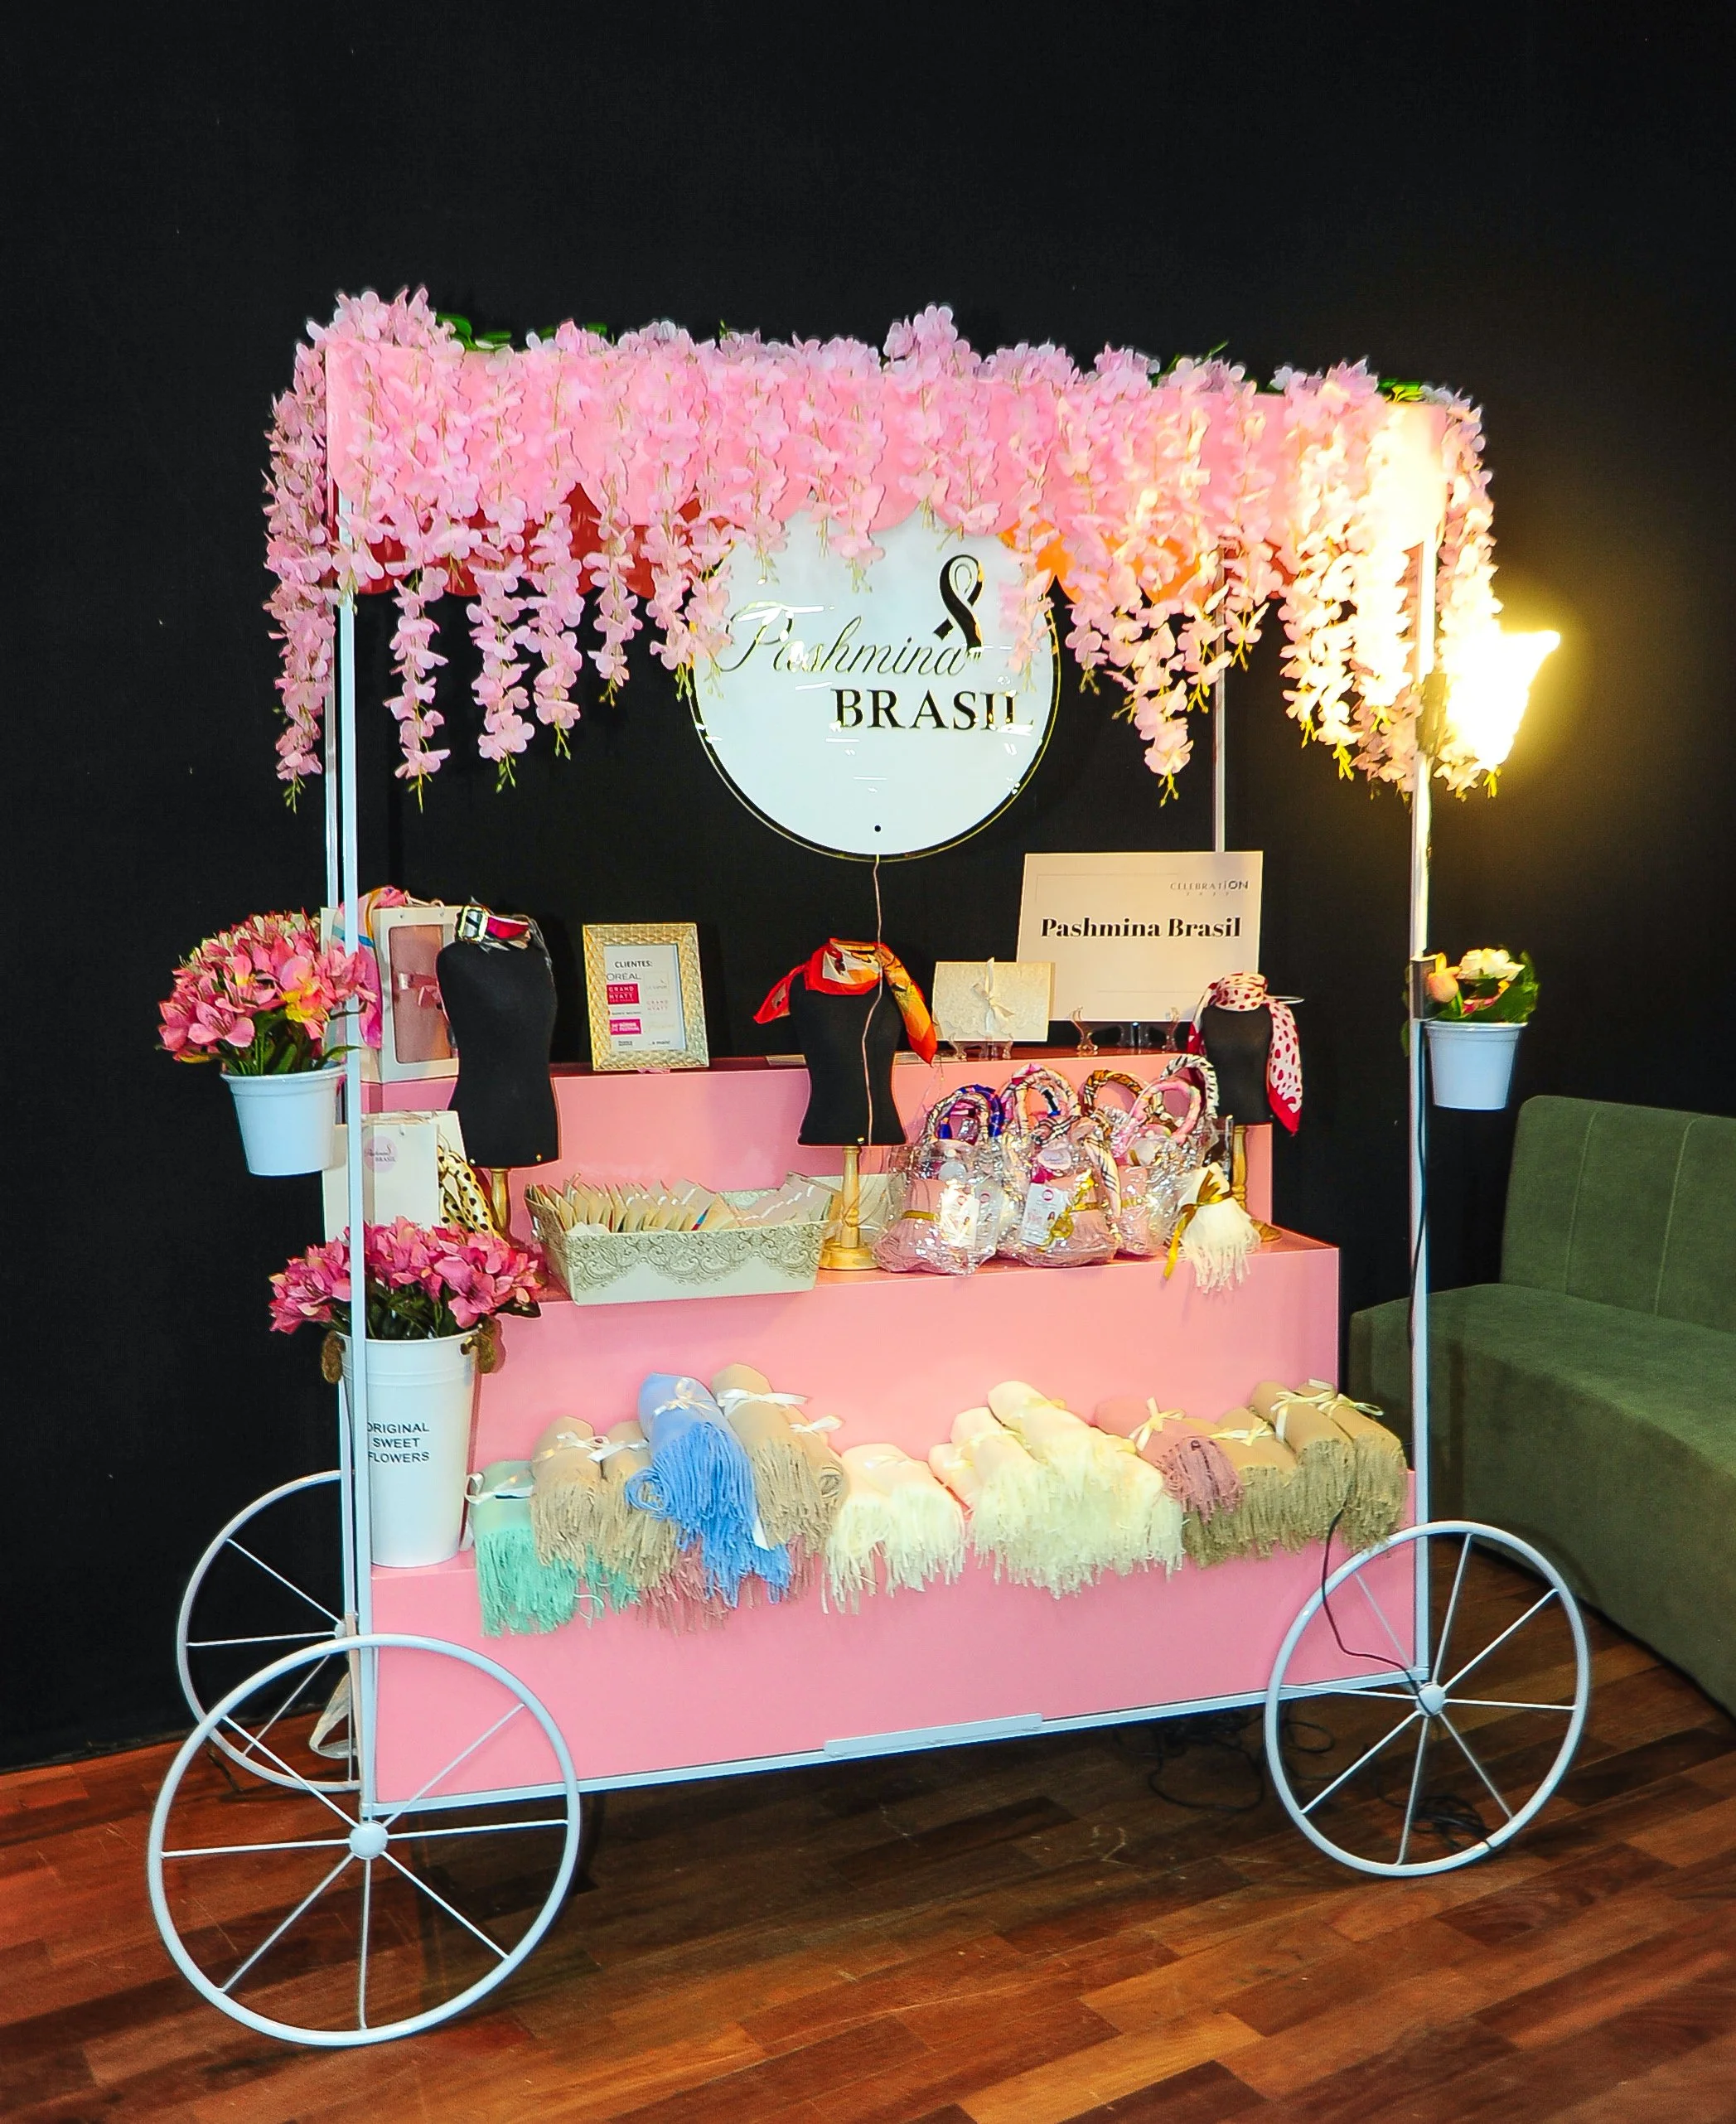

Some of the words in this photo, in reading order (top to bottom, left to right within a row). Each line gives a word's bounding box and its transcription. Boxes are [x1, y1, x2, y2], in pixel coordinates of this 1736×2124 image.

[718, 600, 967, 676] Pashmina
[829, 688, 1034, 731] BRASIL
[1041, 917, 1161, 938] Pashmina
[1168, 917, 1241, 938] Brasil
[367, 1422, 430, 1434] ORIGINAL
[373, 1437, 420, 1449] SWEET
[368, 1451, 430, 1463] FLOWERS
